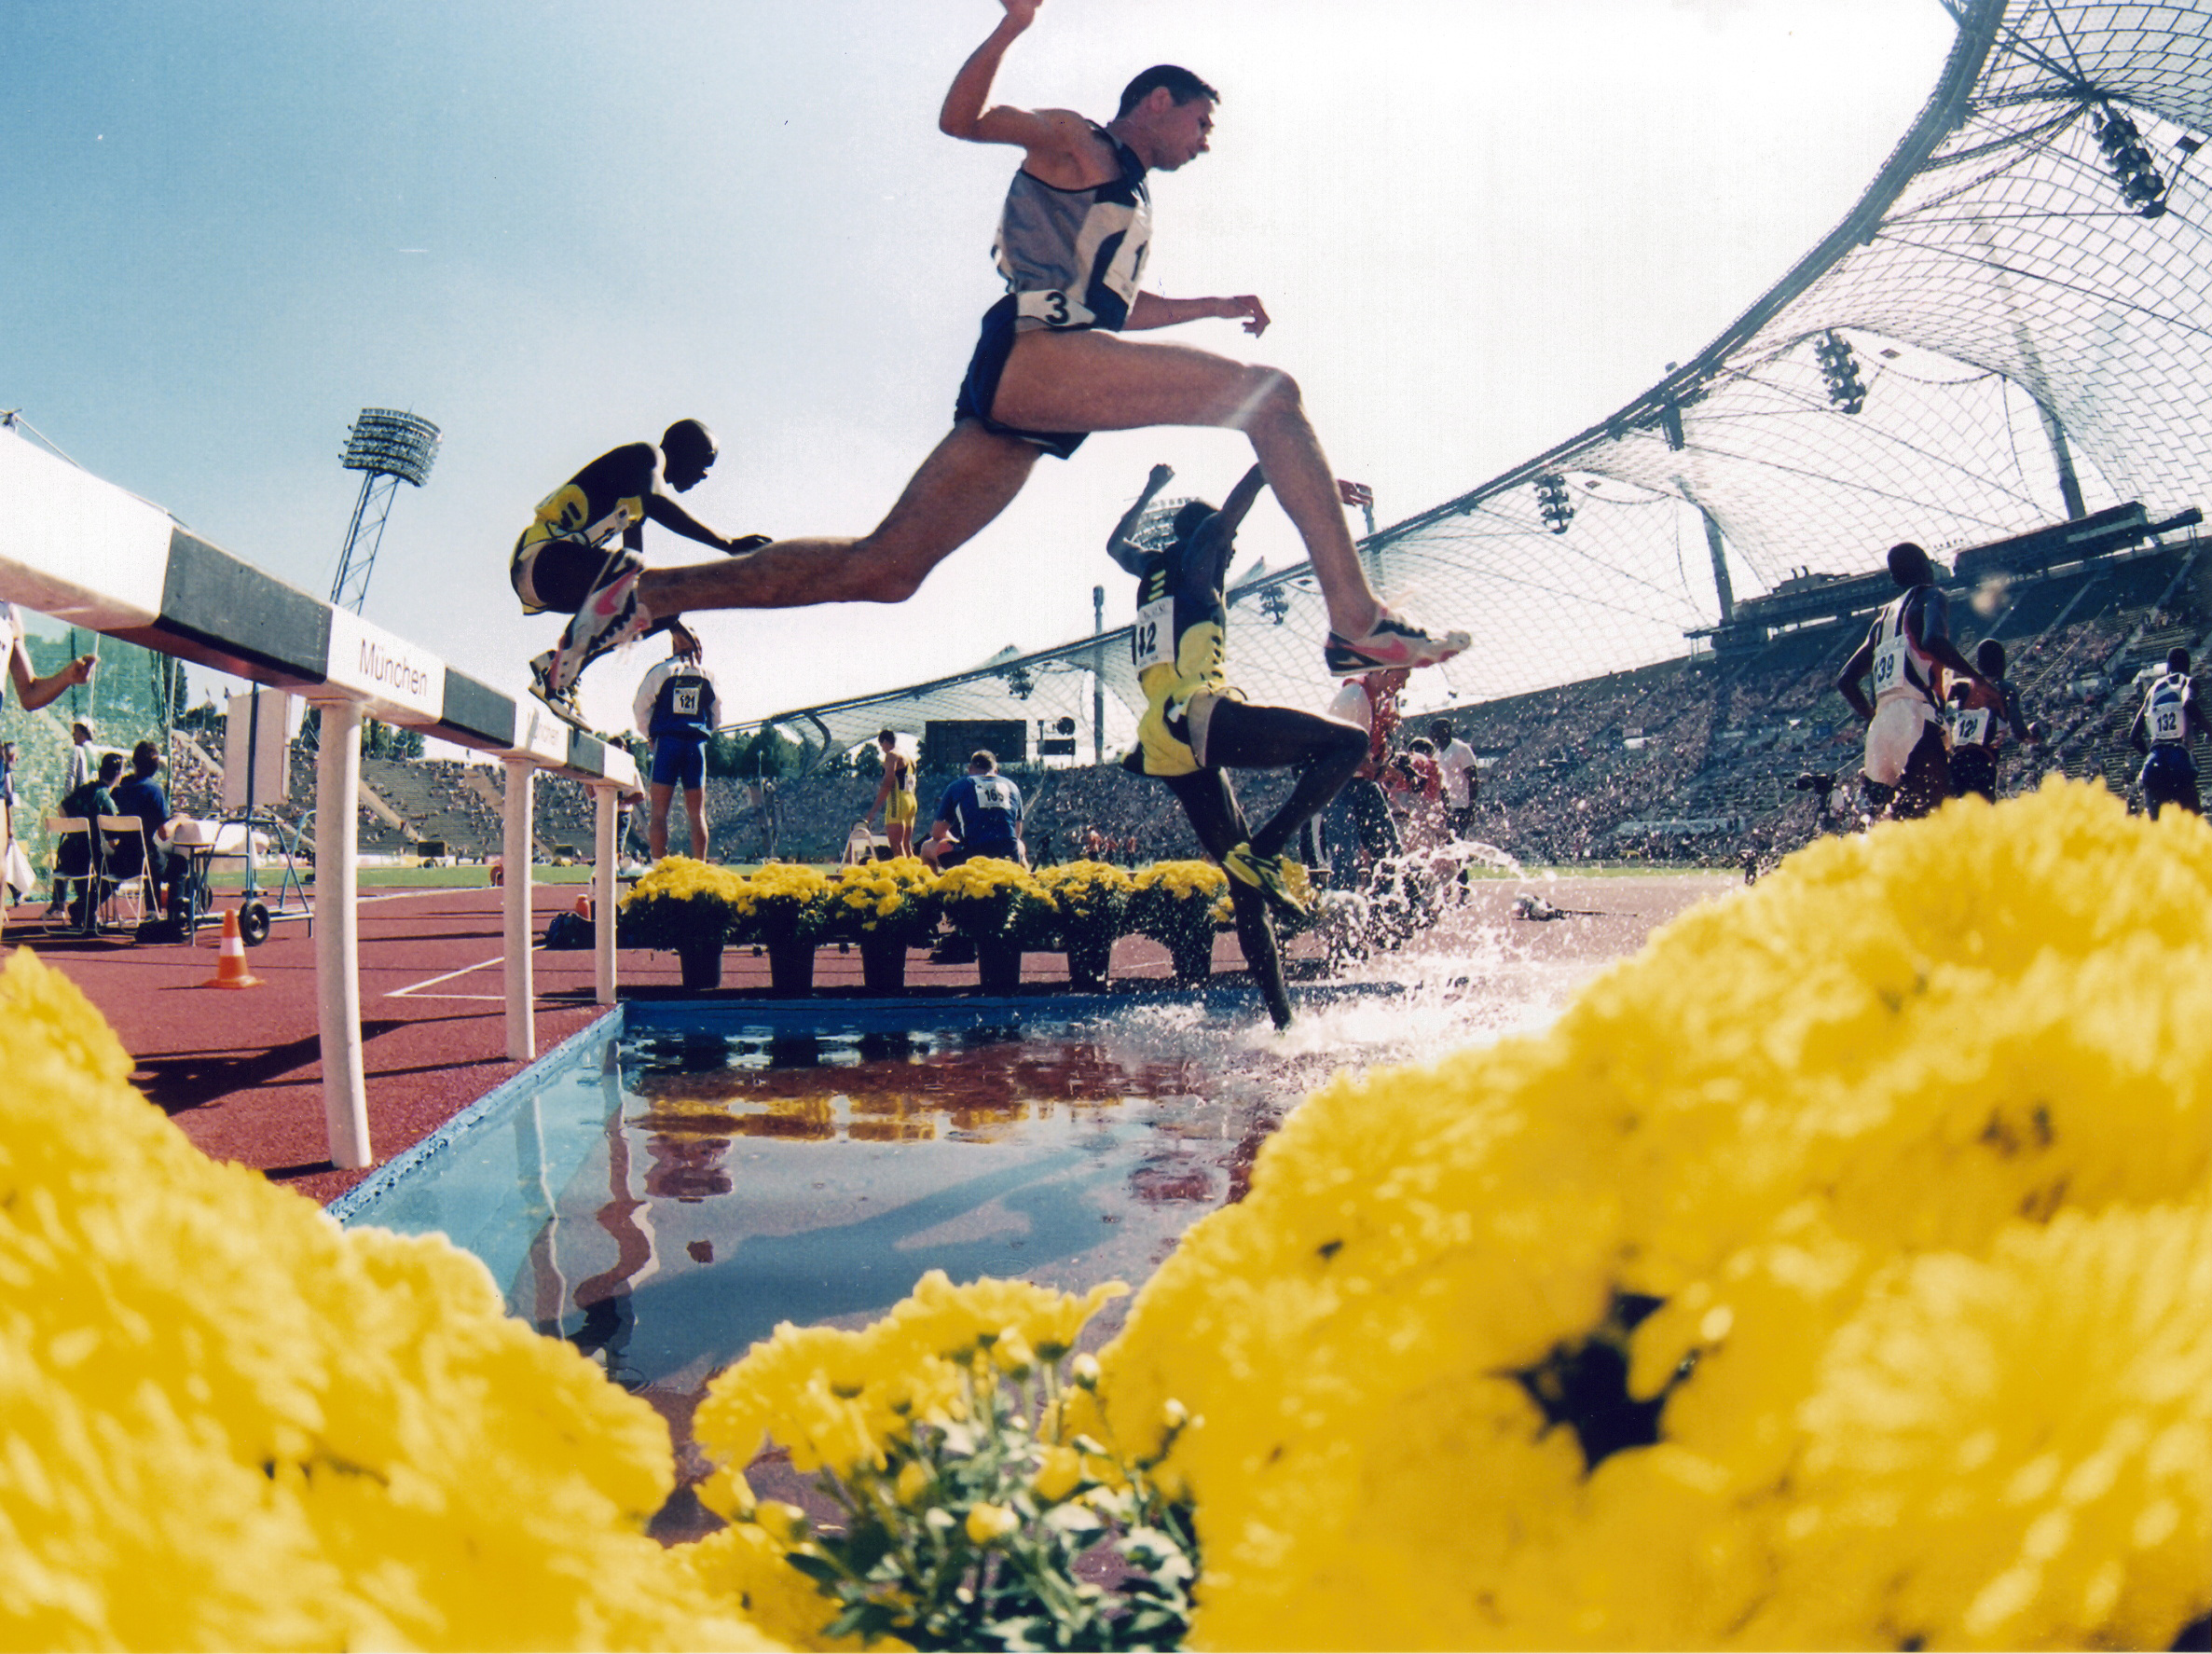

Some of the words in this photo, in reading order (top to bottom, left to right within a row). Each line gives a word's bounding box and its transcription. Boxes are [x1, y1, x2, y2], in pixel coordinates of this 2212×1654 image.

[1046, 292, 1069, 324] 3
[360, 638, 427, 696] München
[680, 695, 695, 709] 121
[2157, 712, 2177, 732] 132
